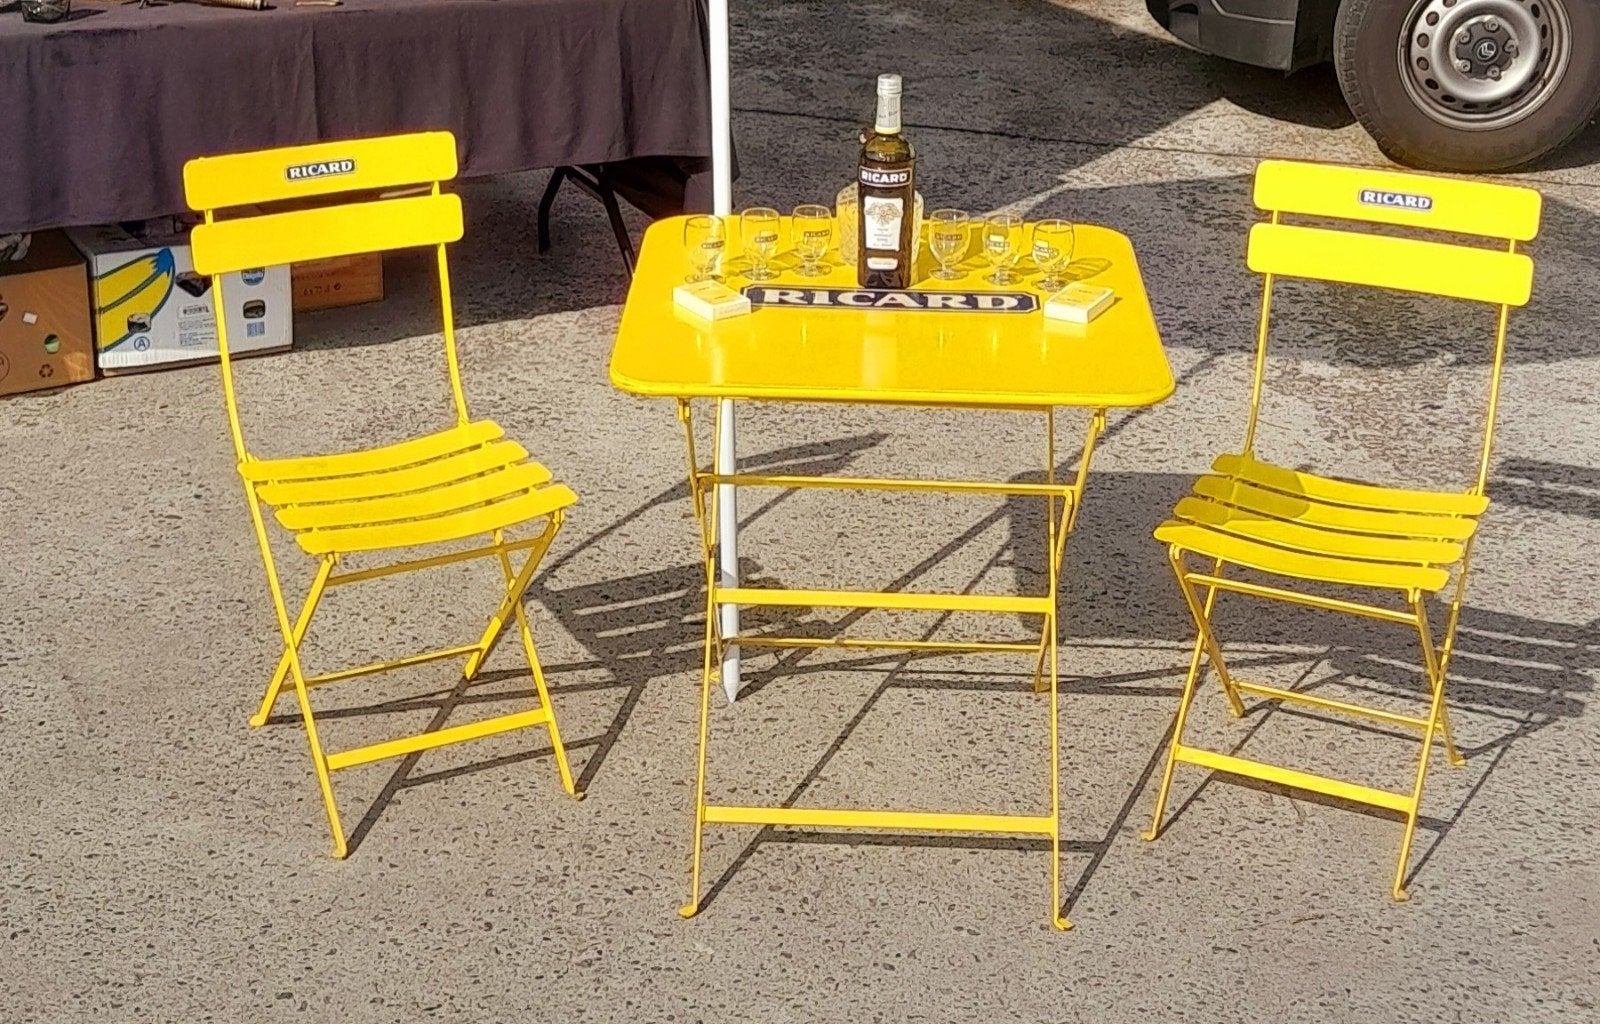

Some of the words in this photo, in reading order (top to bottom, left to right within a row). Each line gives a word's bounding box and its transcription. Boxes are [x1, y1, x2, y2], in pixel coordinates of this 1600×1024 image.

[289, 160, 352, 178] RICARD
[861, 170, 908, 183] RICARD
[1363, 191, 1430, 208] RICARD
[761, 288, 1019, 310] RICARD
